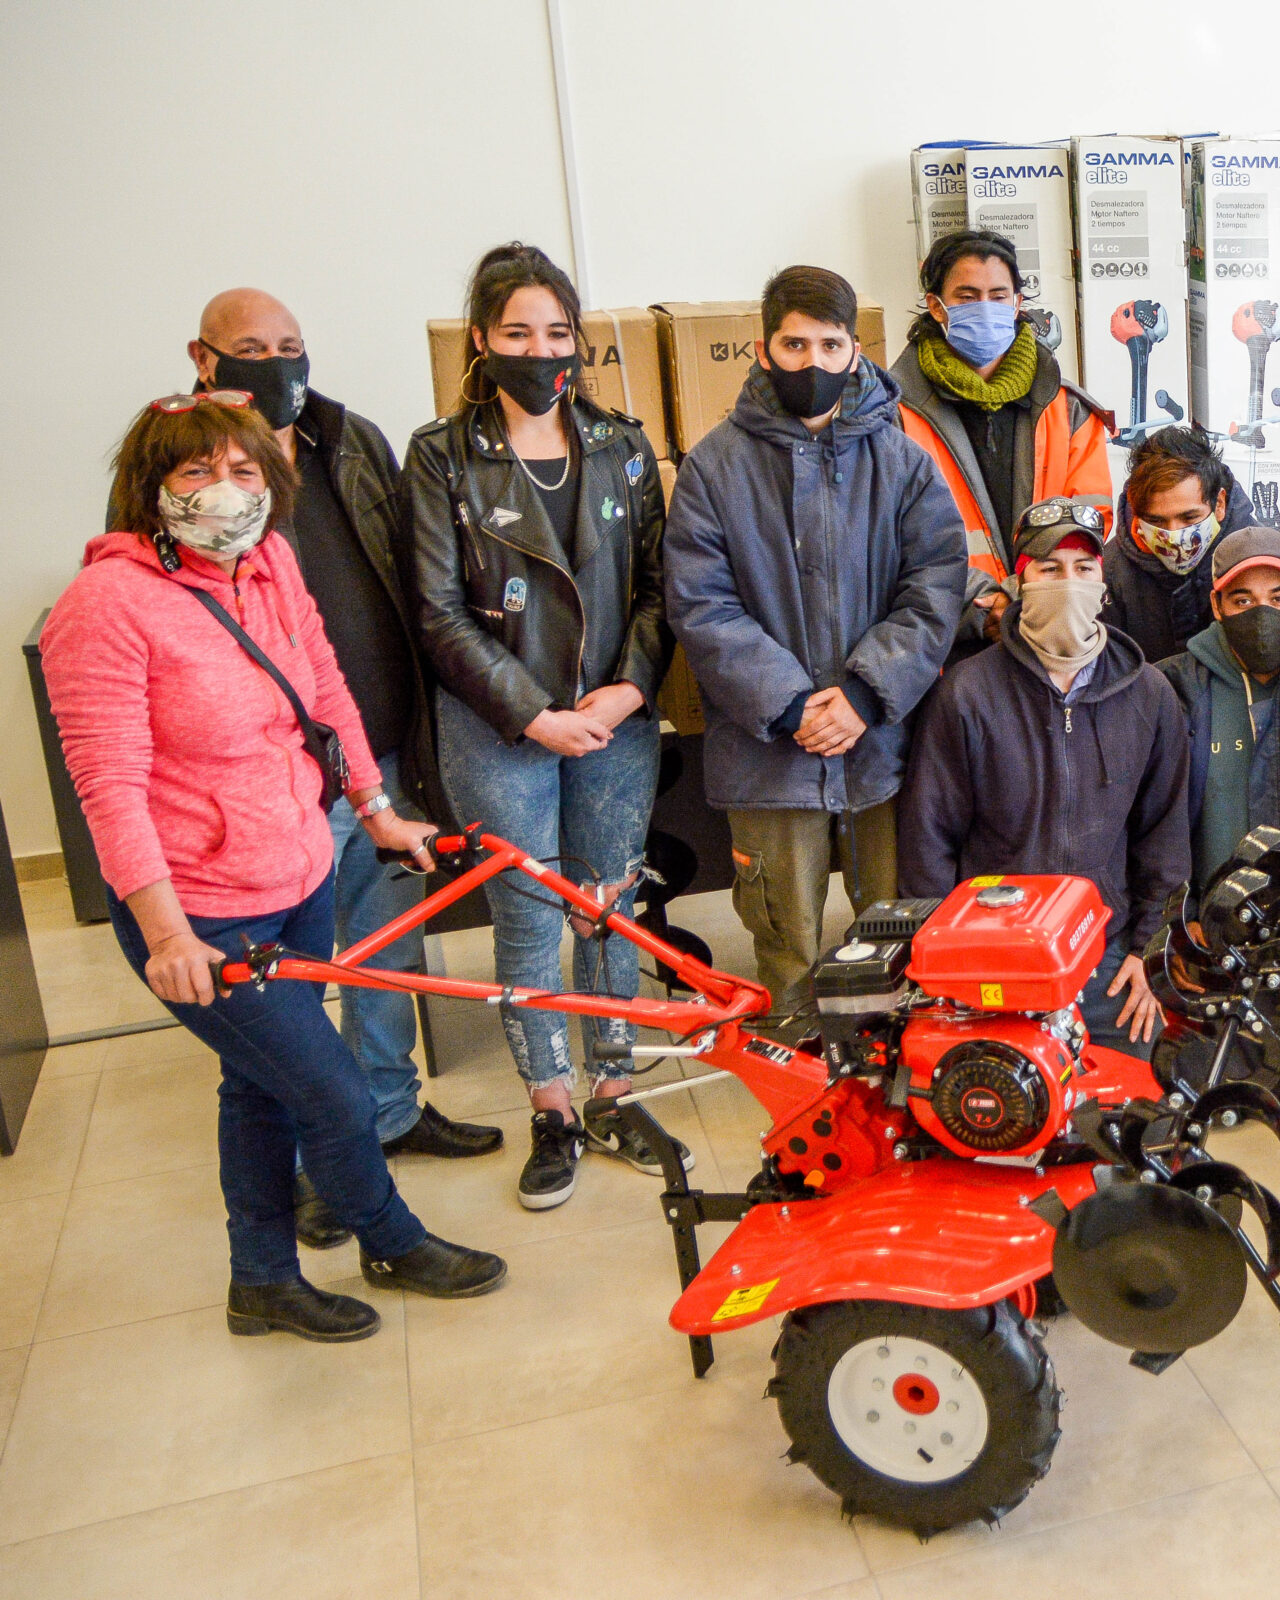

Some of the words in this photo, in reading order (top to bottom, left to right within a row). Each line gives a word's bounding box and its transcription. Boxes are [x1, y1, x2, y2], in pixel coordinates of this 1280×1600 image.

[1083, 152, 1175, 166] GAMMA
[971, 165, 1064, 179] GAMMA
[1086, 167, 1128, 184] elite
[1212, 169, 1250, 186] elite
[926, 177, 967, 195] elite
[974, 180, 1017, 197] elite
[1091, 200, 1145, 208] Desmalezadora
[1216, 201, 1265, 209] Desmalezadora
[979, 213, 1034, 221] Desmalezadora
[1091, 210, 1112, 218] Motor
[932, 220, 952, 229] Motor
[1003, 222, 1029, 231] Naftero
[1097, 220, 1126, 229] tiempos
[1222, 221, 1247, 230] tiempos
[1092, 244, 1104, 253] 44
[1107, 245, 1119, 253] cc
[1216, 243, 1228, 252] 44
[1230, 245, 1242, 253] cc
